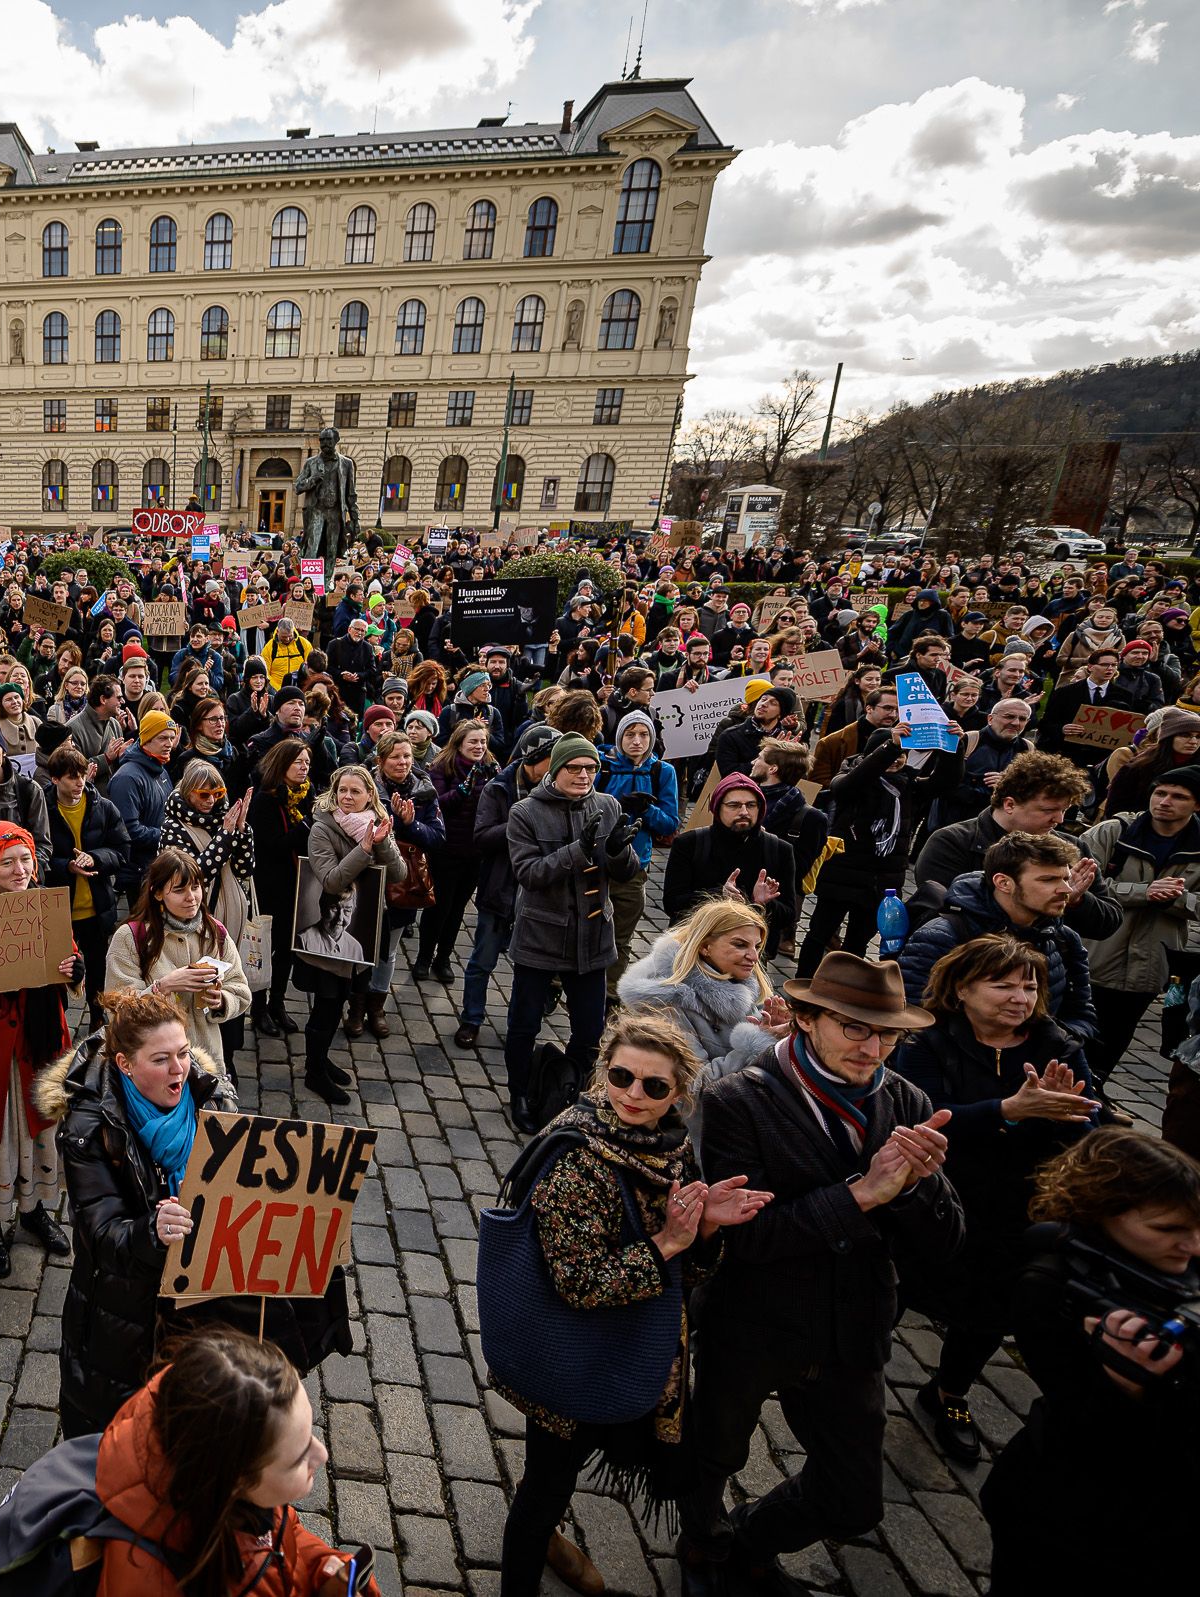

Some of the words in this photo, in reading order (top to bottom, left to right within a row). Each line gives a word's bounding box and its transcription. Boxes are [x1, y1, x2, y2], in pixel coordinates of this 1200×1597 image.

[133, 511, 205, 534] ODBORY
[302, 565, 322, 573] 40%
[457, 586, 508, 597] Humanitky
[688, 696, 744, 712] Univerzita
[690, 709, 728, 722] Hradec
[201, 1114, 308, 1193] YES
[306, 1123, 378, 1203] WE
